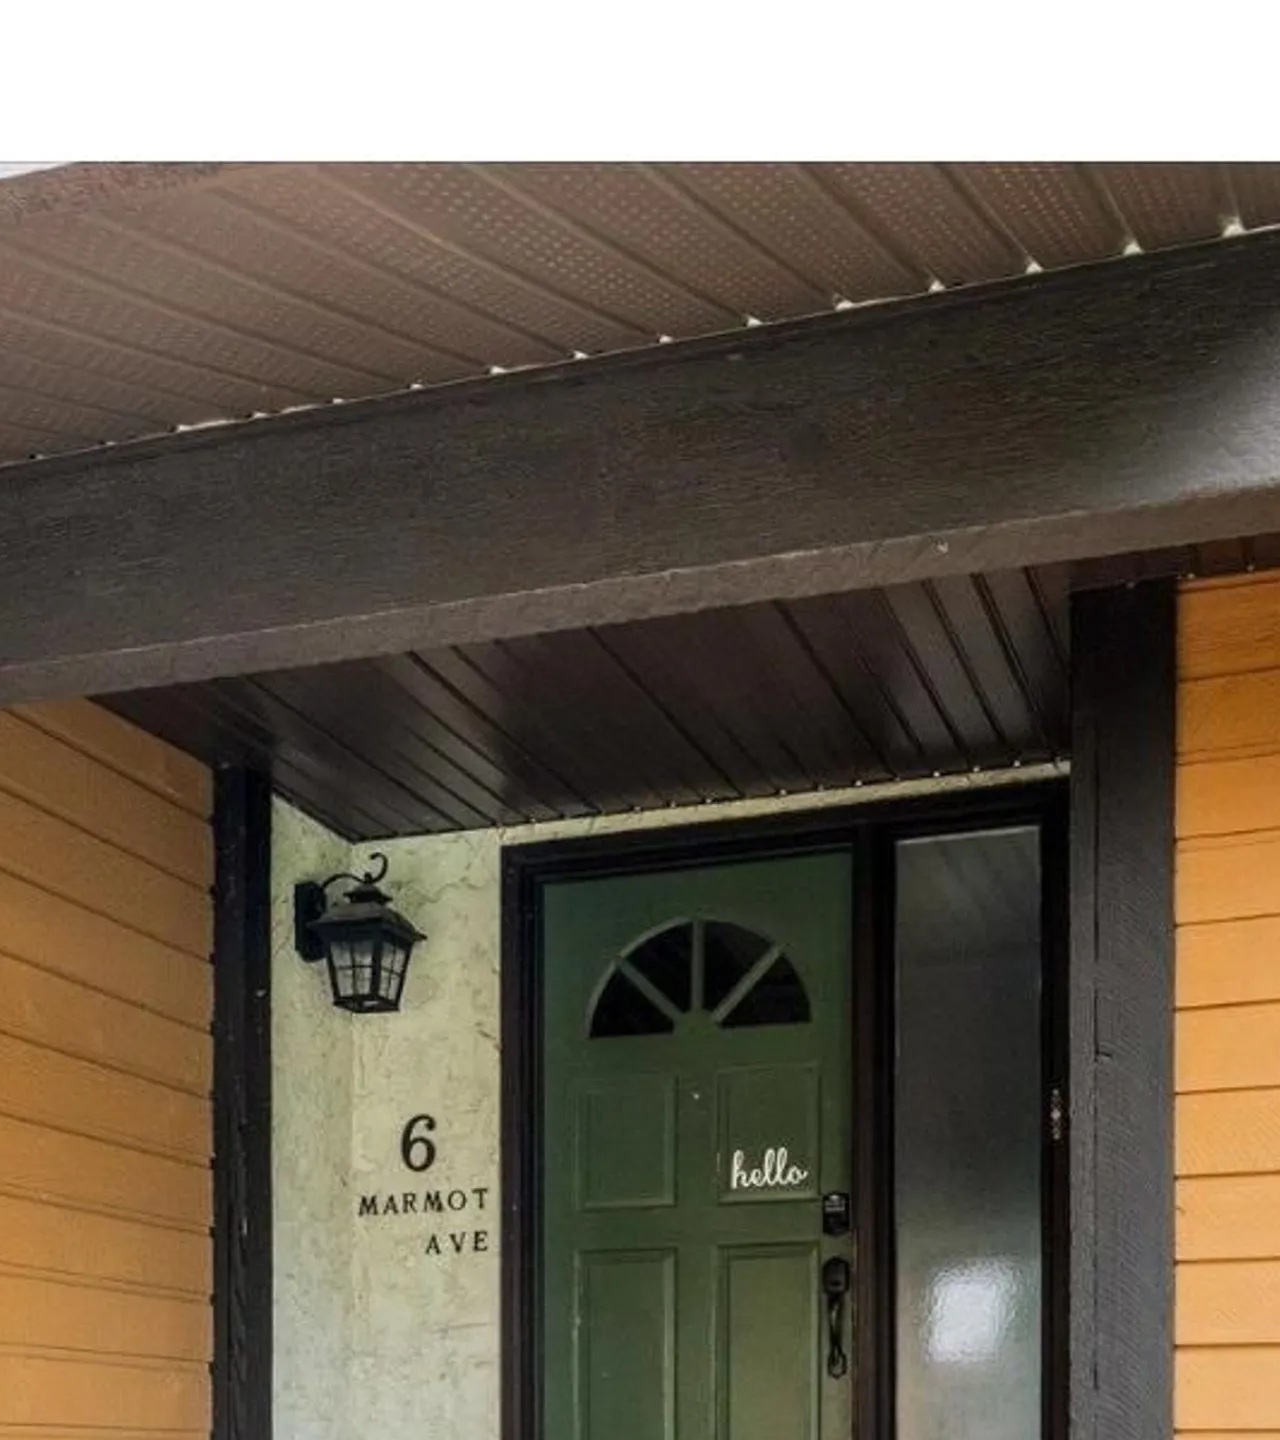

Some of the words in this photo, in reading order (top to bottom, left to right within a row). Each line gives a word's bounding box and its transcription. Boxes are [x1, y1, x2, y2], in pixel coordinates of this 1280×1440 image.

[401, 1114, 436, 1172] 6
[731, 1147, 809, 1190] hello
[358, 1188, 488, 1217] MARMOT
[425, 1230, 488, 1255] AVE
